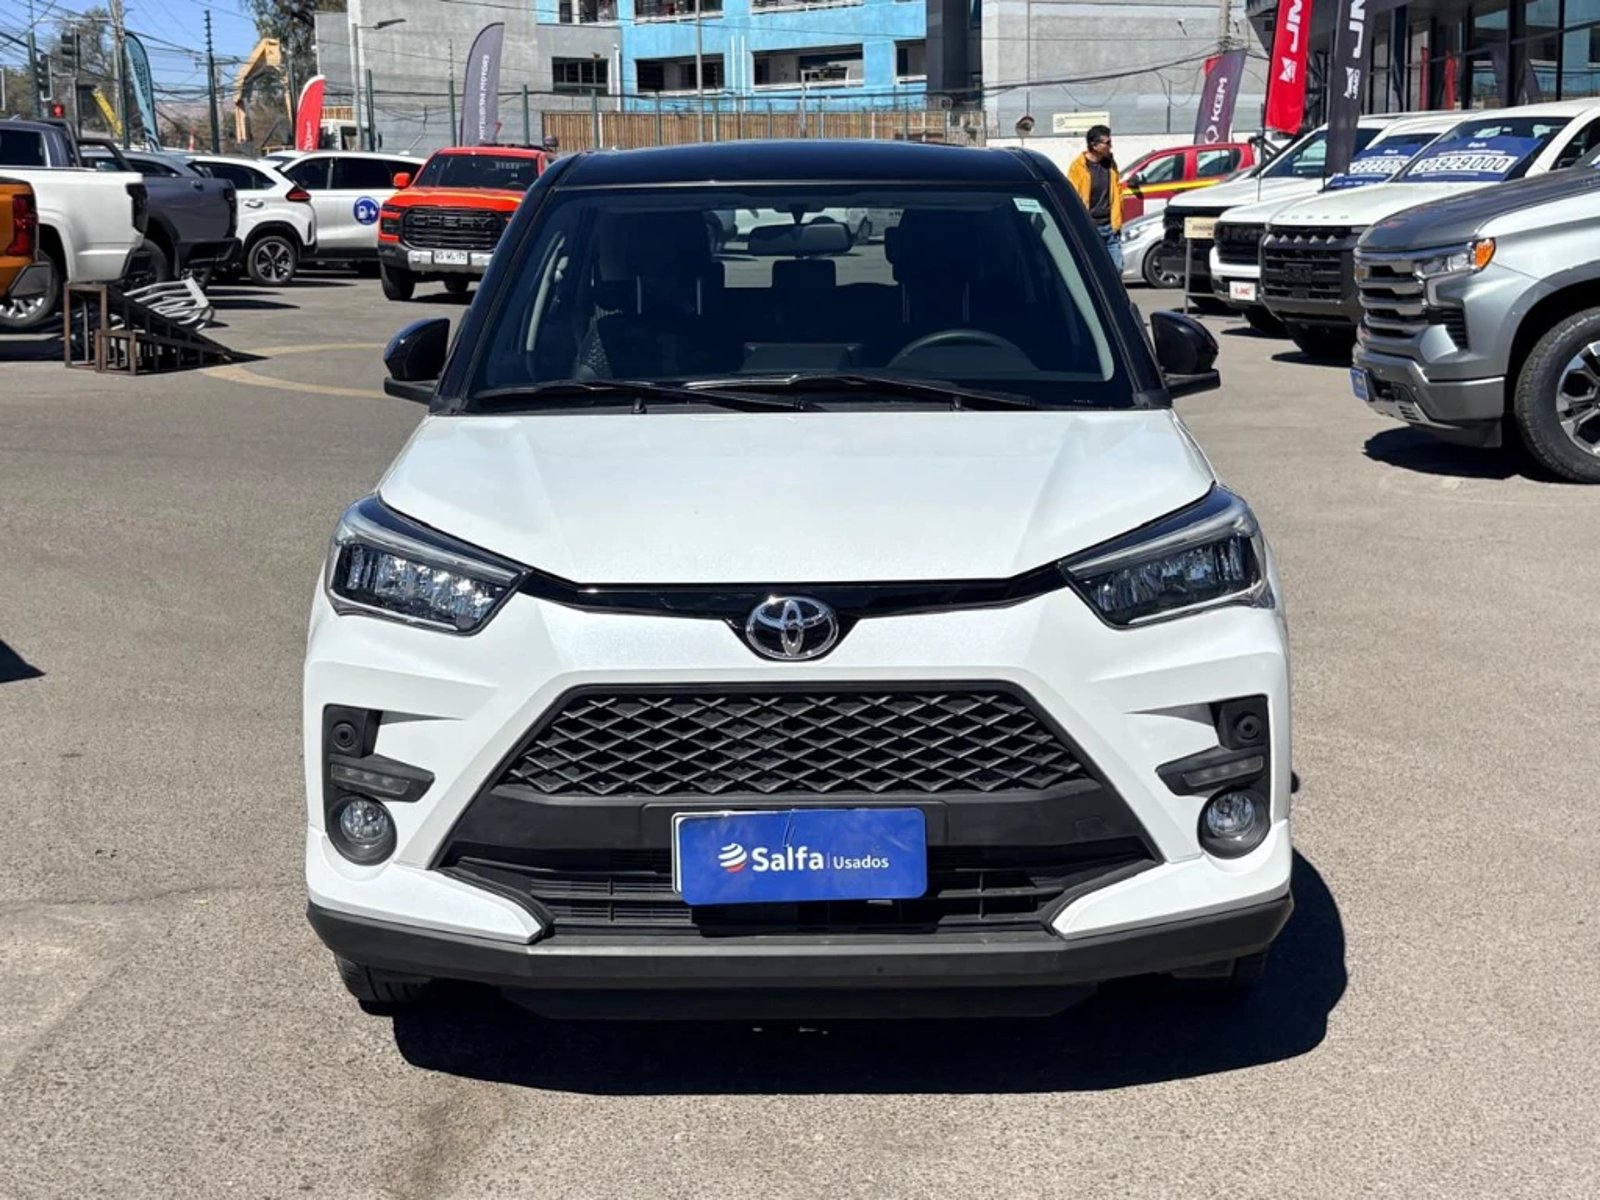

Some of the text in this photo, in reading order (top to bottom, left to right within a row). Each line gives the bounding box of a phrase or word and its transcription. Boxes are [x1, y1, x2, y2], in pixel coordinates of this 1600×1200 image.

[1210, 77, 1228, 122] KGM
[412, 215, 493, 228] CHERY
[751, 846, 890, 872] Salfa Usados
